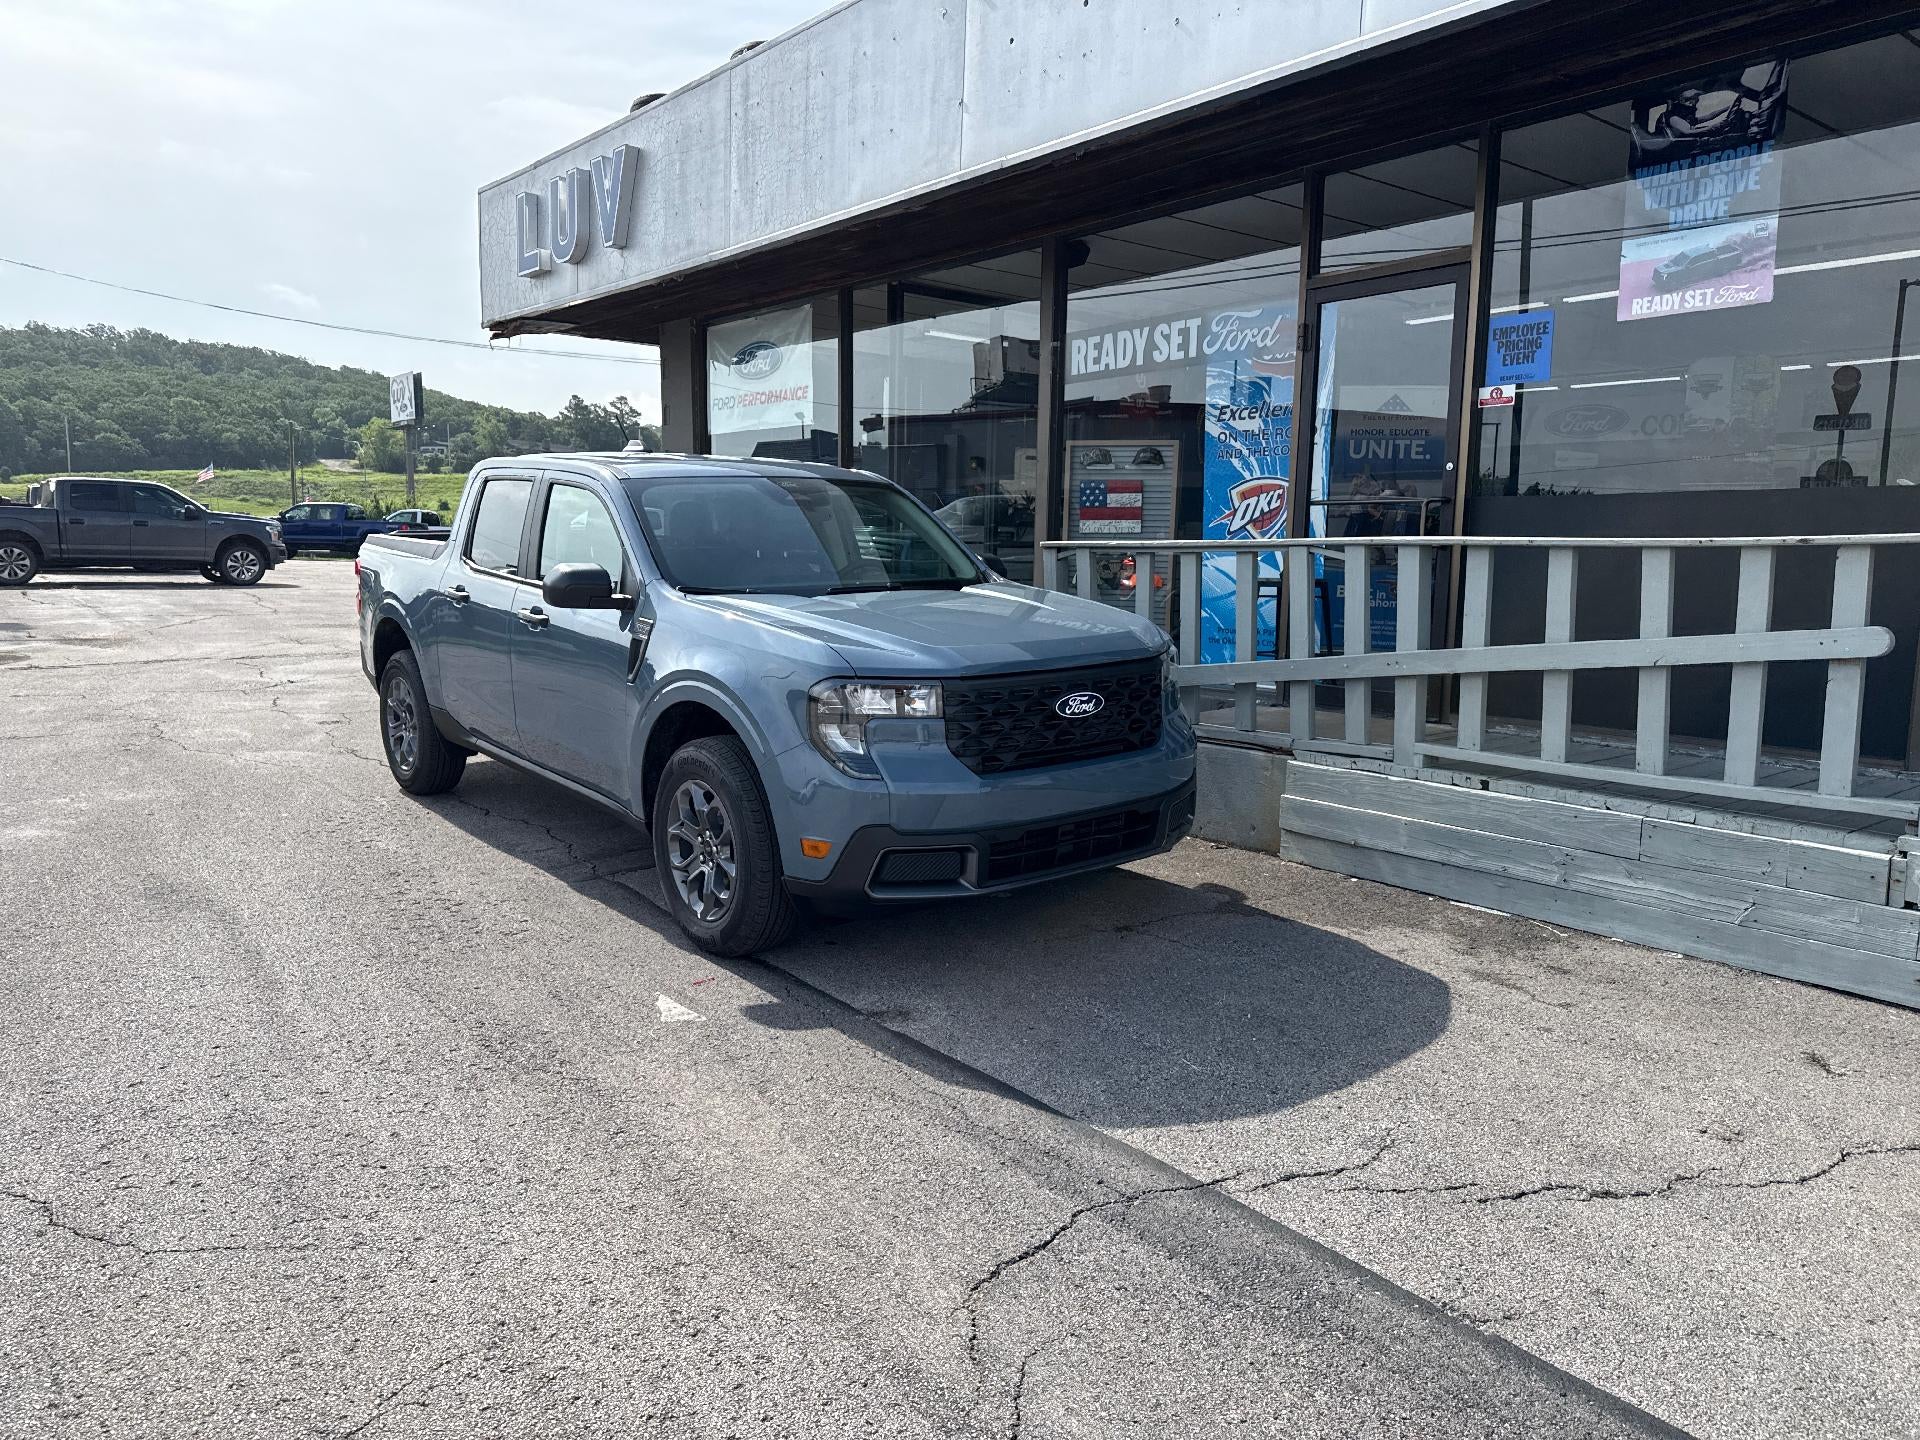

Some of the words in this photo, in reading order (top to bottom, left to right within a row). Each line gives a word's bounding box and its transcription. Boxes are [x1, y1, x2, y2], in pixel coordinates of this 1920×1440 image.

[1635, 158, 1690, 190] WHAT
[1694, 140, 1775, 178] PEOPLE
[1643, 181, 1693, 211] WITH
[1698, 166, 1761, 202] DRIVE
[516, 144, 640, 278] LUV
[1668, 197, 1731, 231] DRIVE
[1631, 291, 1683, 316] READY
[1684, 288, 1714, 309] SET
[1714, 284, 1764, 304] Ford
[1071, 326, 1151, 376] READY
[1152, 317, 1202, 363] SET
[1203, 308, 1284, 355] Ford
[1493, 321, 1550, 341] EMPLOYEE
[1497, 336, 1543, 354] PRICING
[1502, 350, 1537, 367] EVENT
[713, 395, 736, 412] FORD
[737, 385, 809, 409] PERFORMANCE
[1217, 431, 1238, 443] ON
[1242, 428, 1271, 443] THE
[1389, 427, 1432, 437] EDUCATE.
[1217, 447, 1243, 460] AND
[1246, 445, 1270, 458] THE
[1349, 439, 1431, 460] UNITE.
[1229, 488, 1284, 532] OKC
[1065, 695, 1096, 714] Ford
